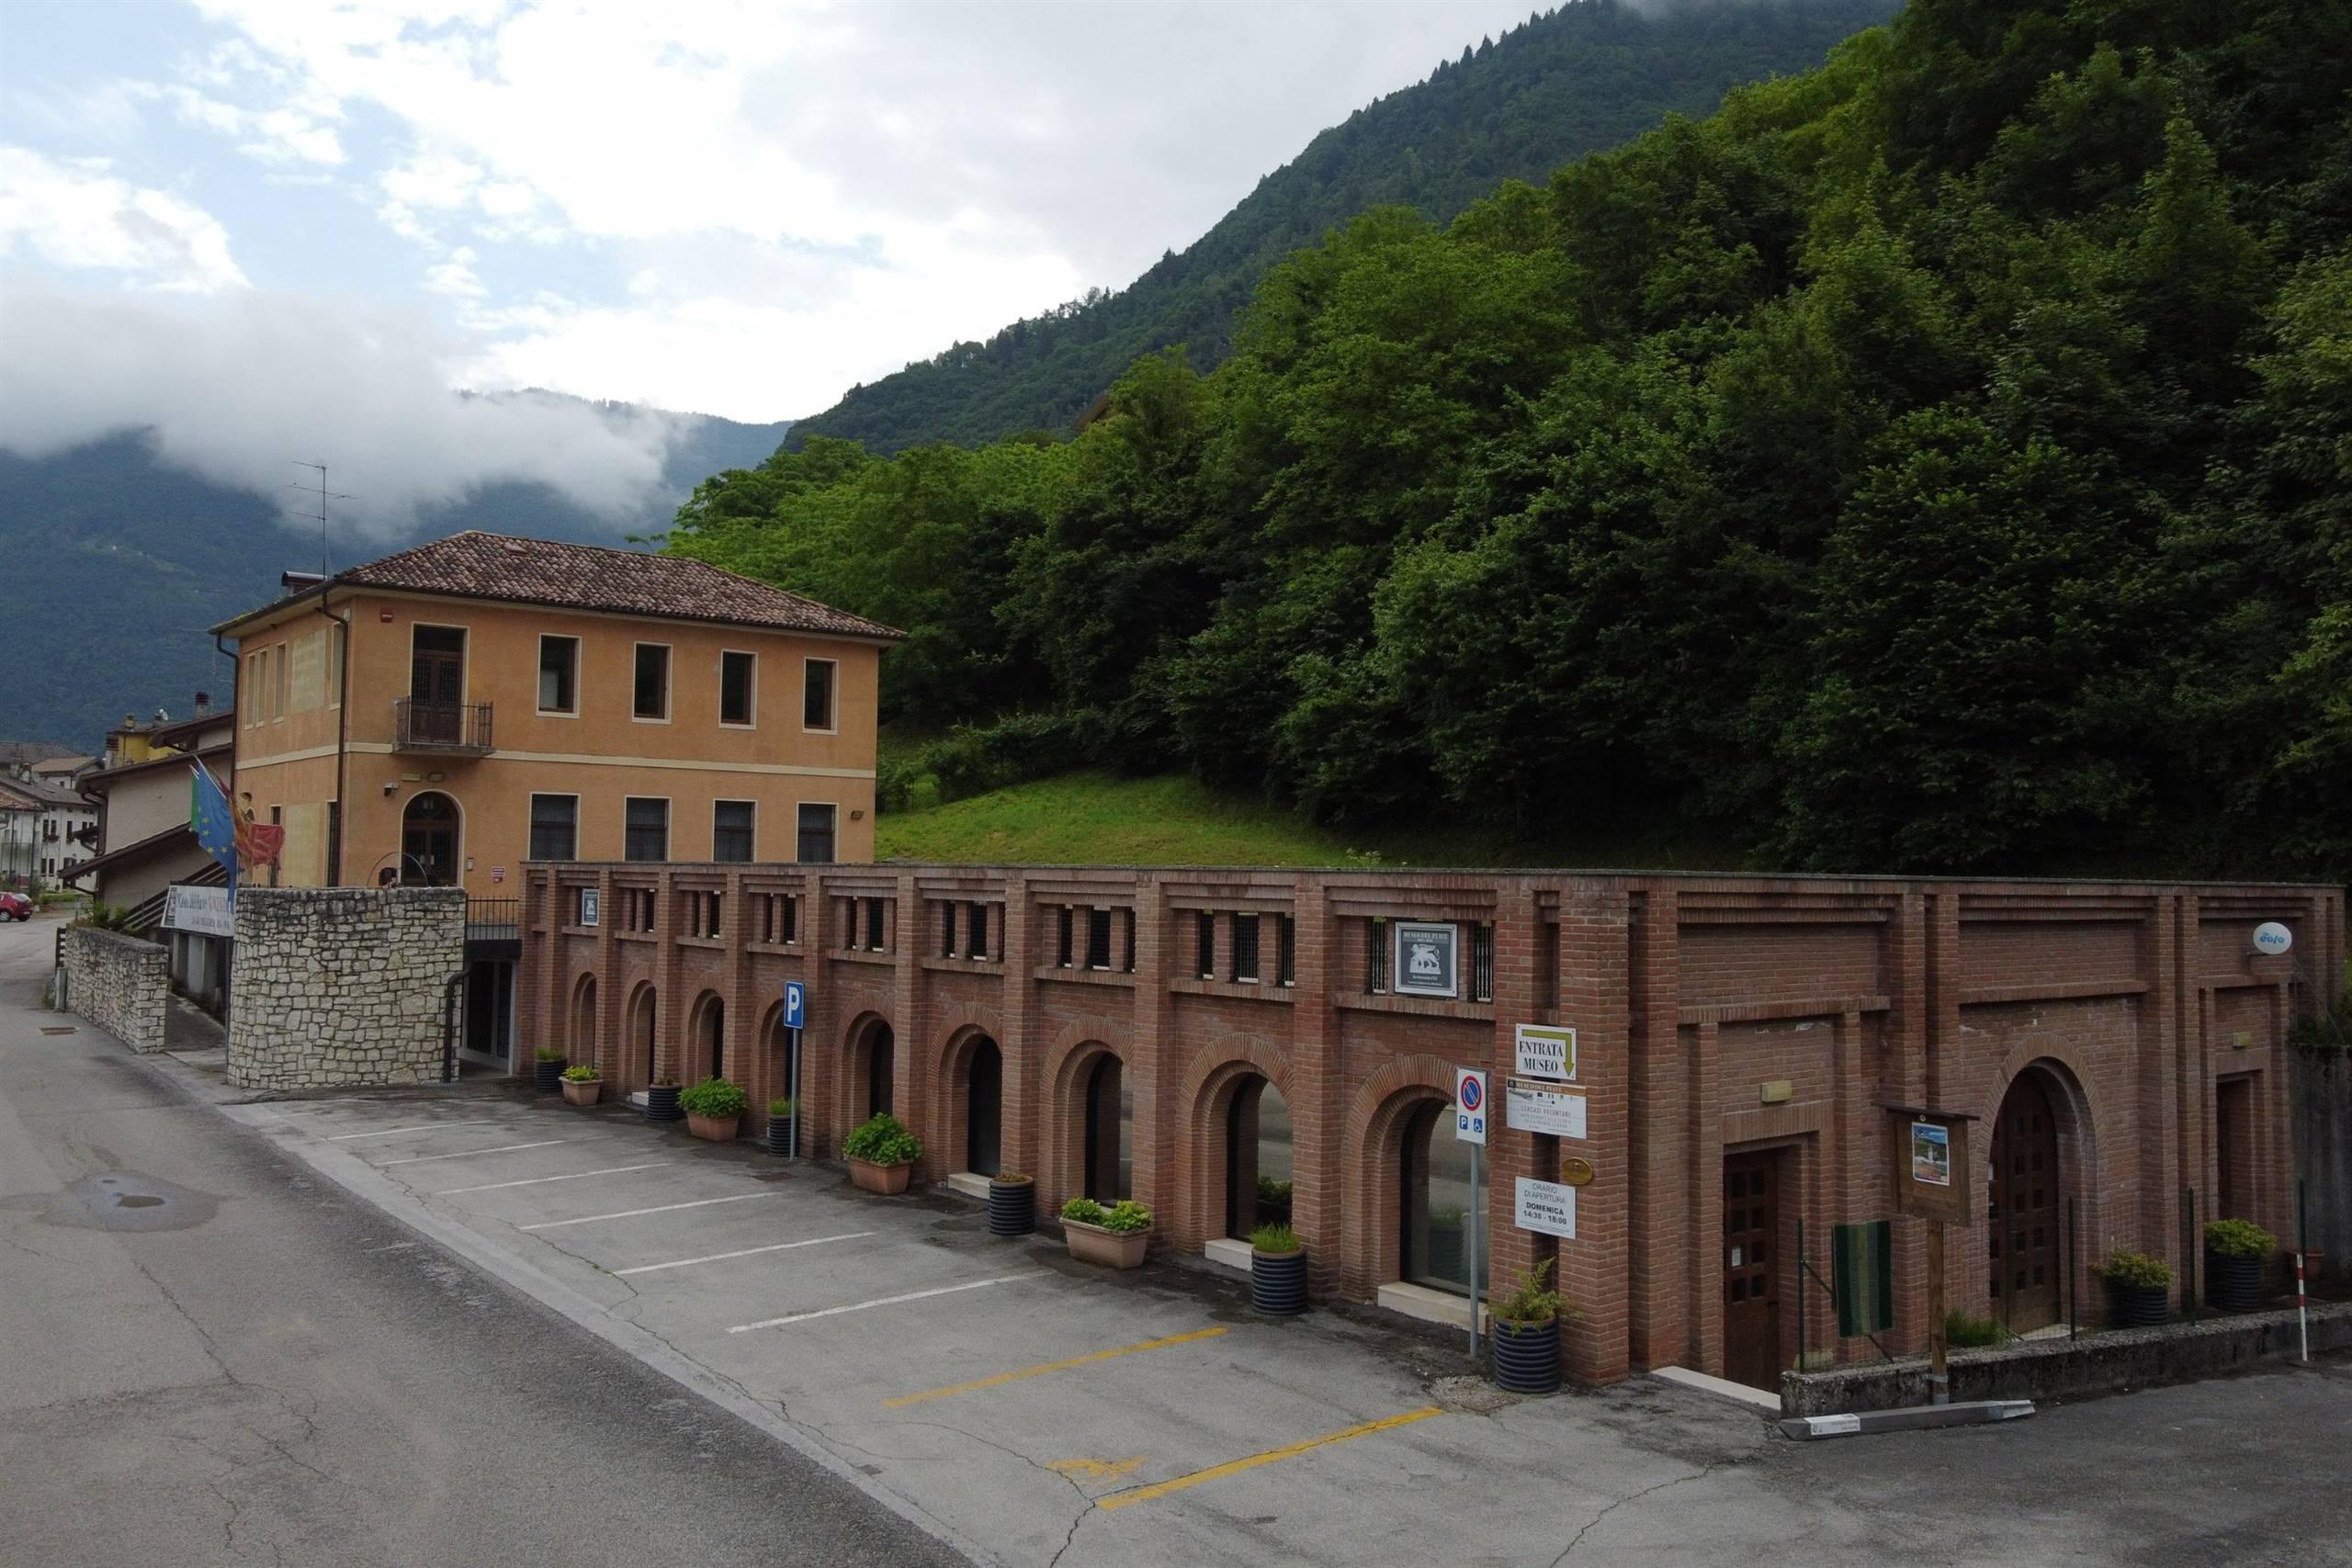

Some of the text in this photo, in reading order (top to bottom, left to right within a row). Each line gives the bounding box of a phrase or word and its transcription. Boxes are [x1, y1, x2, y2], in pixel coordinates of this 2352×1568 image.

[787, 987, 800, 1022] P
[1519, 1041, 1564, 1057] ENTRATA
[1524, 1057, 1558, 1073] MUSEO
[1461, 1117, 1467, 1127] P
[1532, 1183, 1558, 1194] ORARIO
[1524, 1190, 1566, 1204] DI APERTURA
[1526, 1201, 1565, 1215] DOMENICA
[1523, 1210, 1543, 1220] 14:30
[1548, 1215, 1567, 1224] 18:00
